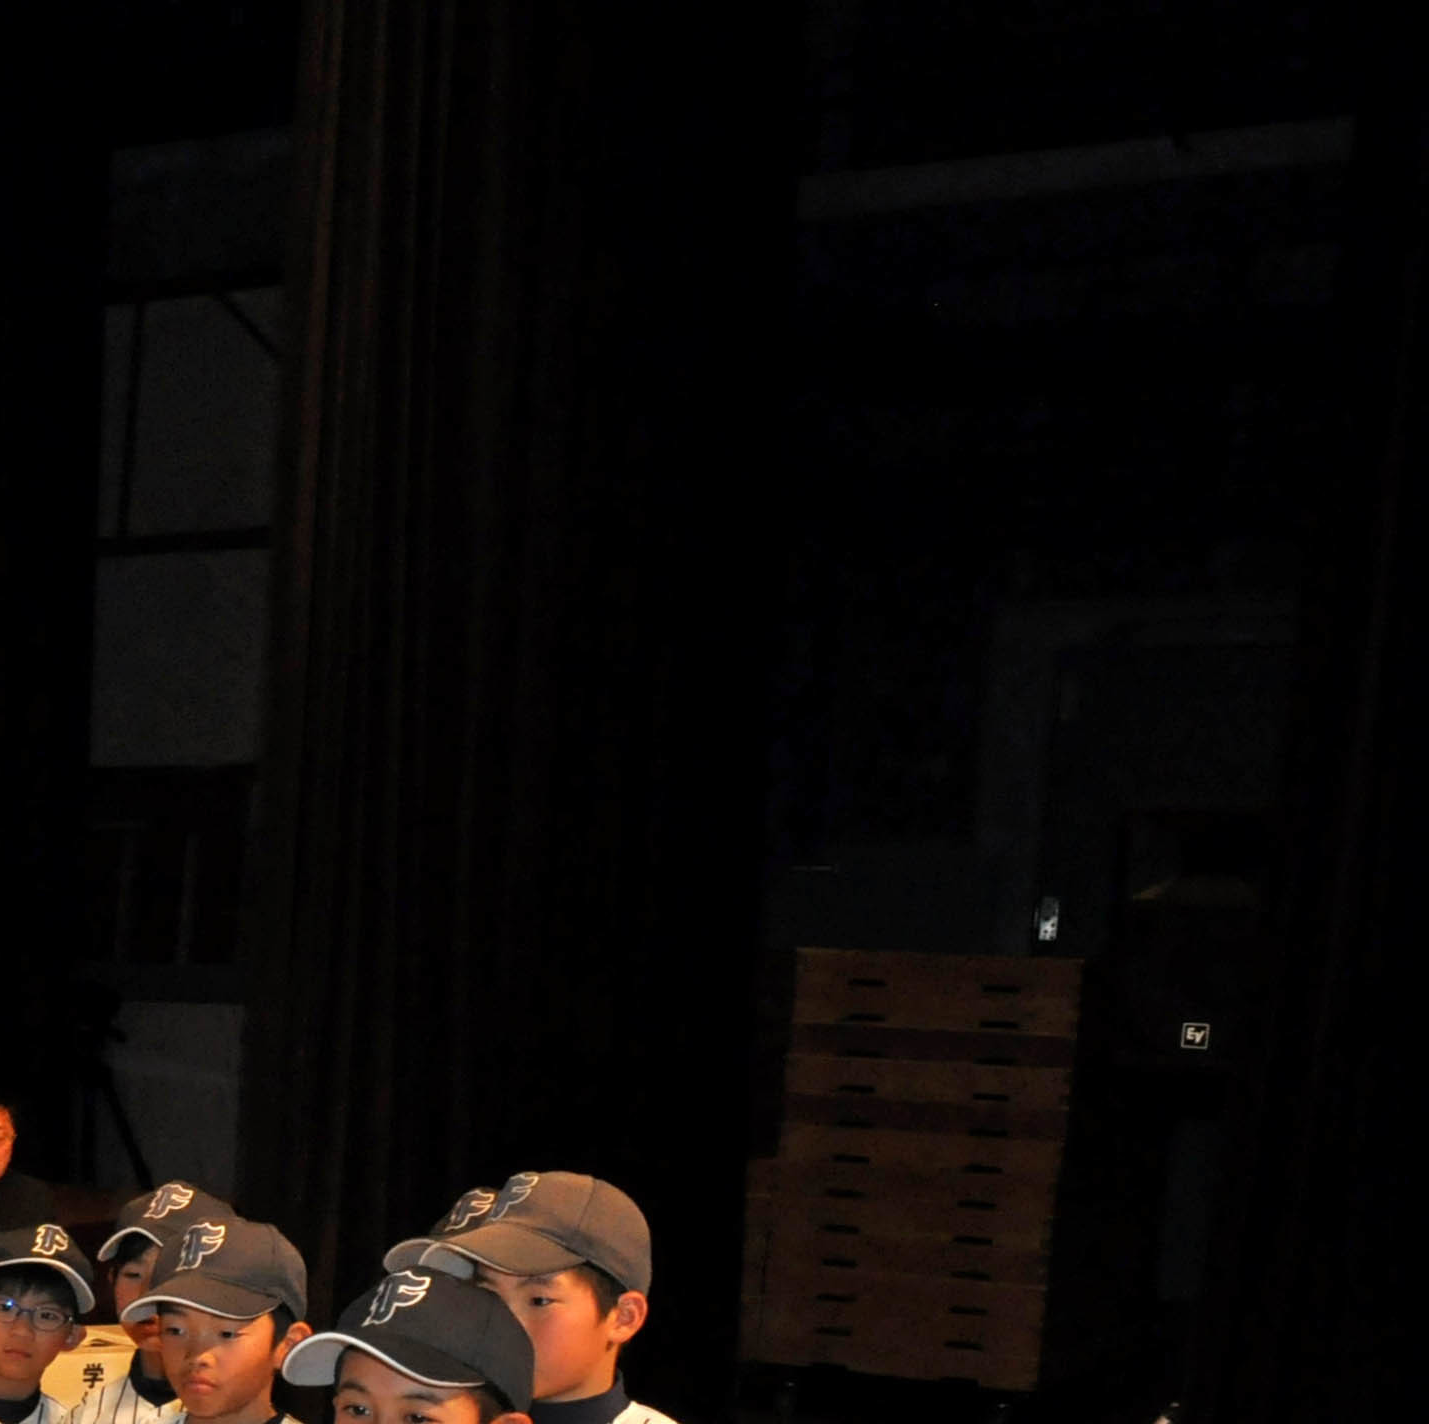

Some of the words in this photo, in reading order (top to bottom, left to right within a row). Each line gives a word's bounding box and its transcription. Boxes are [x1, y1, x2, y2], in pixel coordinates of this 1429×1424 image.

[143, 1184, 194, 1219] F
[444, 1190, 495, 1232] F
[491, 1173, 540, 1221] F
[32, 1223, 69, 1255] F
[175, 1222, 226, 1272] F
[361, 1270, 431, 1327] F
